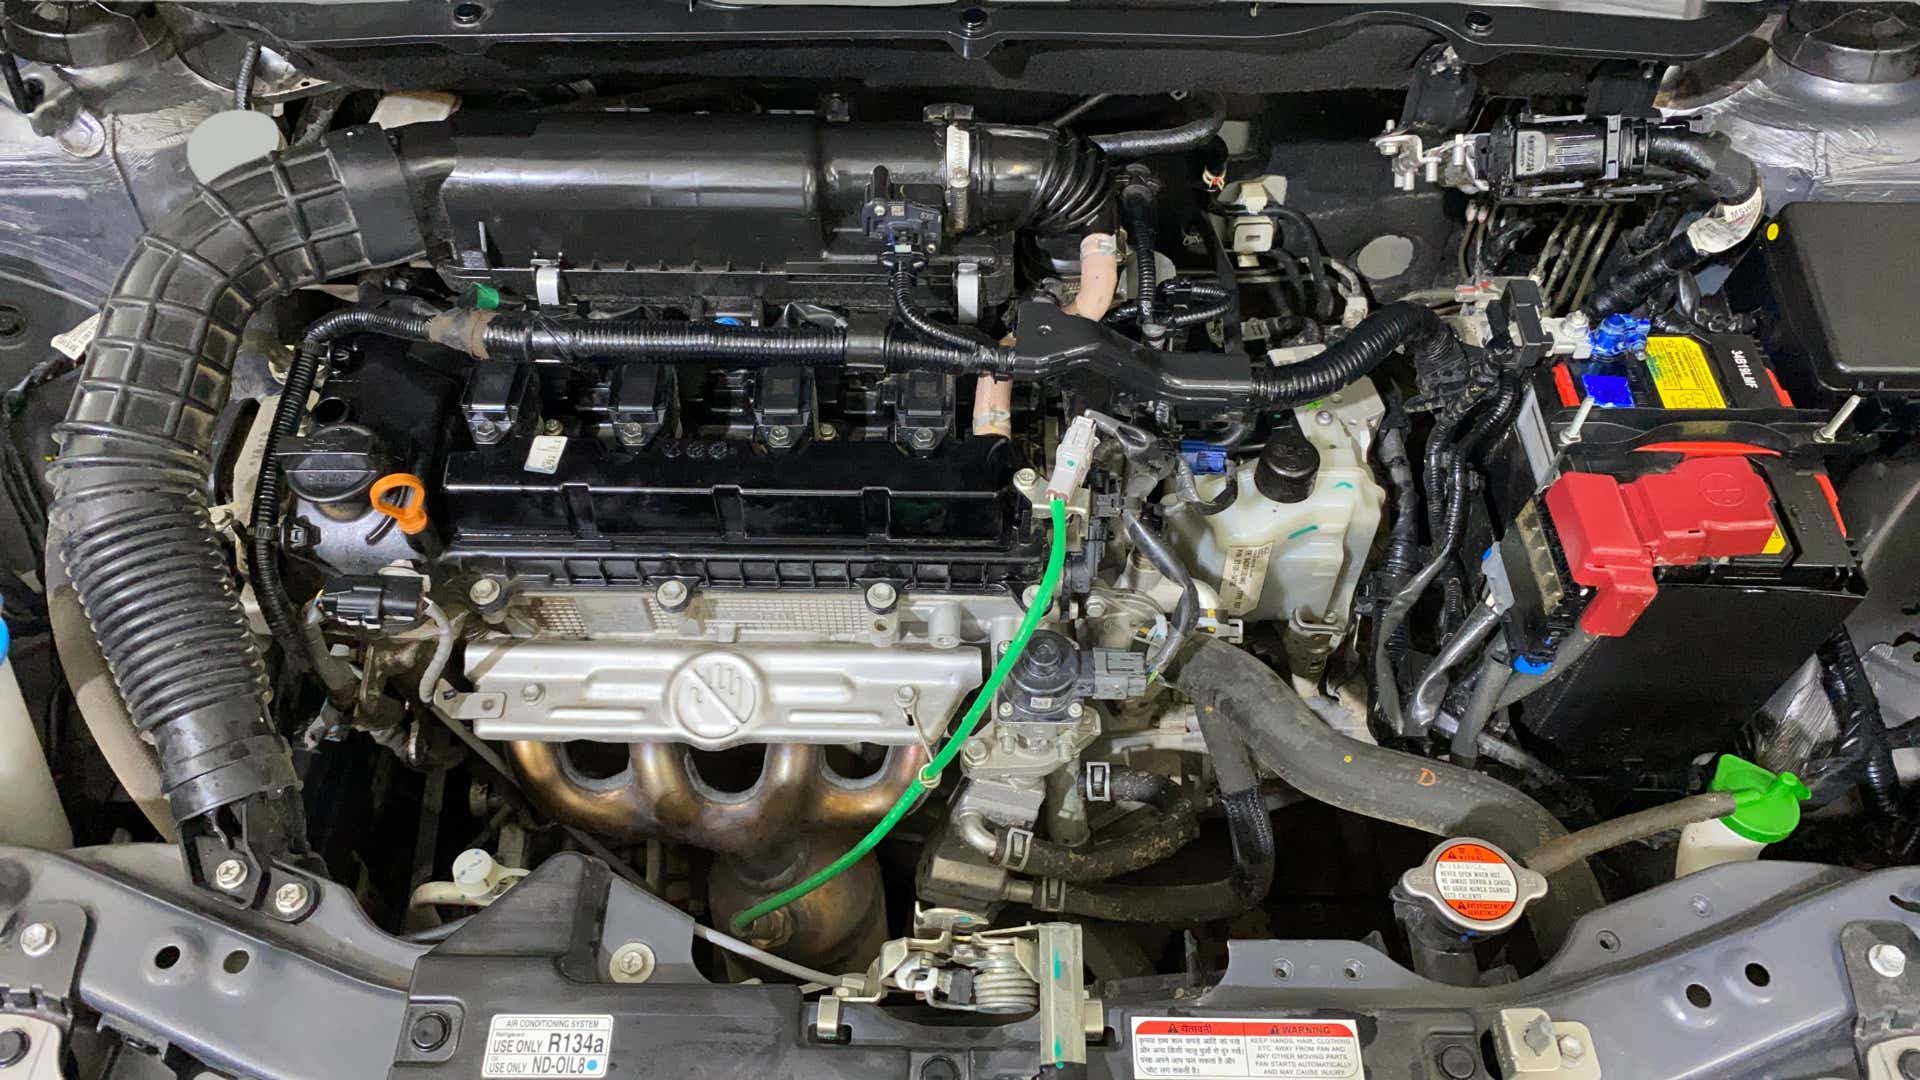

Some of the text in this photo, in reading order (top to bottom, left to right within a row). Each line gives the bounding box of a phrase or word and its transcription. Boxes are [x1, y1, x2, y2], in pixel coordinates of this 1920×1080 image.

[506, 1020, 599, 1028] AIR CONDITIONING SYSTEM
[1181, 1023, 1212, 1034] चेतावनी
[1282, 1026, 1331, 1034] WARNING
[493, 1033, 604, 1053] USE ONLY R134a
[489, 1056, 586, 1074] USE ONLY ND-OIL8
